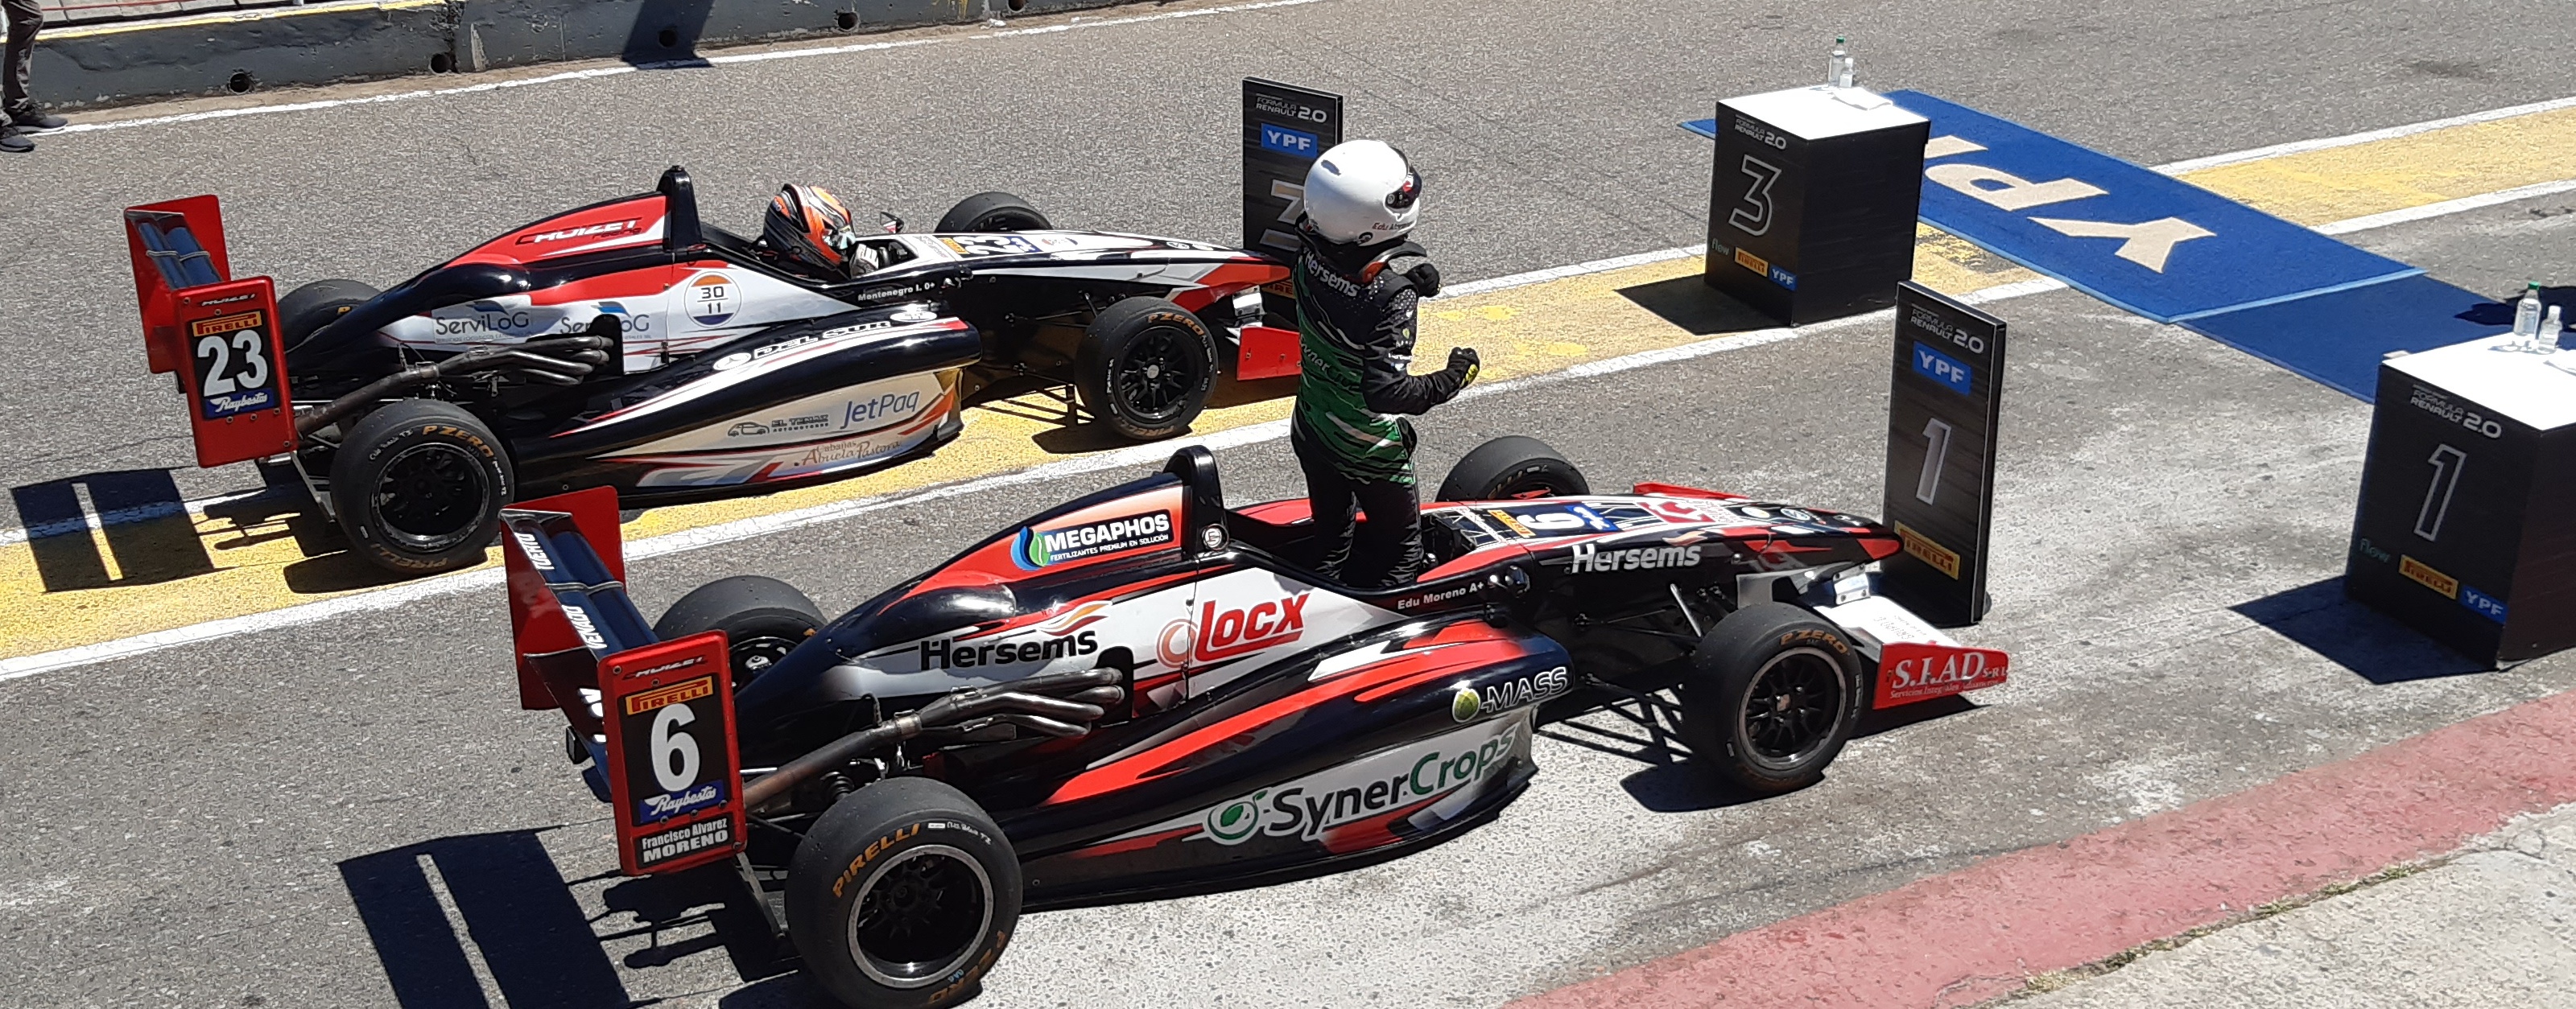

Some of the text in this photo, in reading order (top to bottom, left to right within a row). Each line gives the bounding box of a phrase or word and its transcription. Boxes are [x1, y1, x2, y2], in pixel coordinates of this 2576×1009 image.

[1257, 103, 1327, 122] RENAULT 2.0
[1267, 130, 1311, 150] YPF
[1735, 125, 1765, 142] RENAULT
[1728, 154, 1782, 237] 3
[1304, 252, 1361, 298] Hersems
[1772, 268, 1794, 286] YPF
[701, 286, 724, 299] 30
[708, 301, 722, 315] 11
[857, 286, 914, 302] Montenegro
[196, 313, 258, 335] PIRELLI
[436, 311, 529, 336] ServiLoG
[1148, 312, 1205, 336] P ZERO
[1910, 315, 1984, 354] RENAULT 2.0
[197, 329, 268, 397] 23
[1918, 349, 1964, 384] YPF
[840, 391, 920, 430] JetPaq
[2409, 396, 2502, 439] RENAULT 2.0
[422, 425, 439, 435] P
[439, 425, 494, 458] ZERO
[1915, 416, 1952, 505] 1
[2413, 443, 2468, 543] 1
[1044, 513, 1170, 553] MEGAPHOS
[1048, 546, 1098, 562] FERTILIZANTES
[1571, 544, 1702, 574] Hersems
[1397, 582, 1484, 609] Edu Moreno A+
[2466, 590, 2504, 616] YPF
[919, 629, 1100, 672] Hersems
[1781, 630, 1848, 654] P ZERO
[631, 679, 708, 714] PIRELLI
[650, 702, 700, 793] 6
[642, 817, 728, 850] Francisco Alvarez
[643, 830, 729, 863] MORENO
[832, 822, 921, 898] PIRELLI
